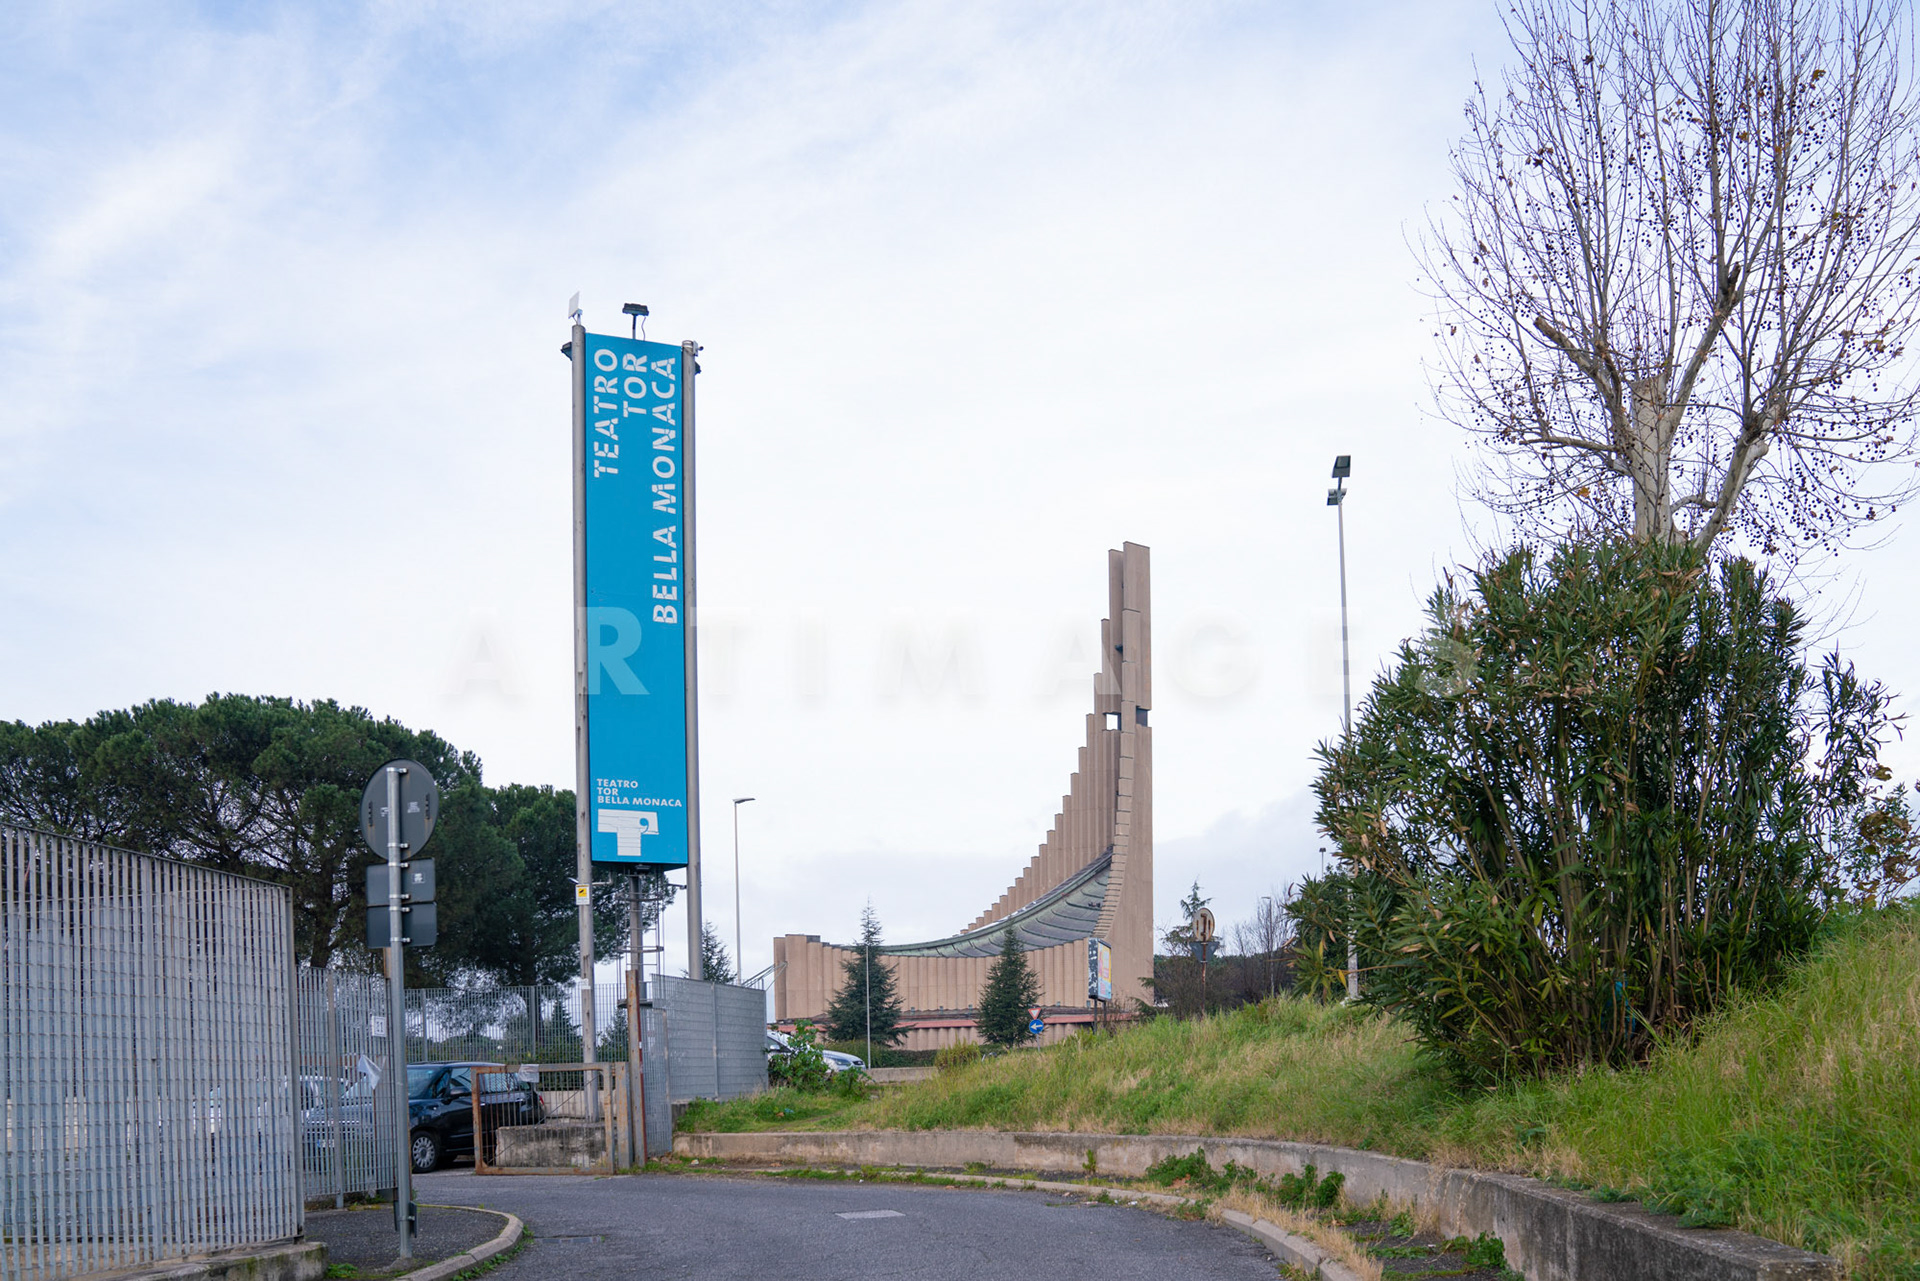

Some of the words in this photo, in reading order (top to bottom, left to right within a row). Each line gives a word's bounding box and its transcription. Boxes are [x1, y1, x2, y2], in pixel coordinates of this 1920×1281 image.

[594, 349, 619, 478] TEATRO
[623, 353, 648, 418] TOR
[652, 357, 677, 515] MONACA
[652, 525, 678, 624] BELLA
[597, 778, 639, 789] TEATRO
[597, 787, 619, 796] TOR
[597, 796, 630, 805] BELLA
[632, 798, 682, 807] MONACA
